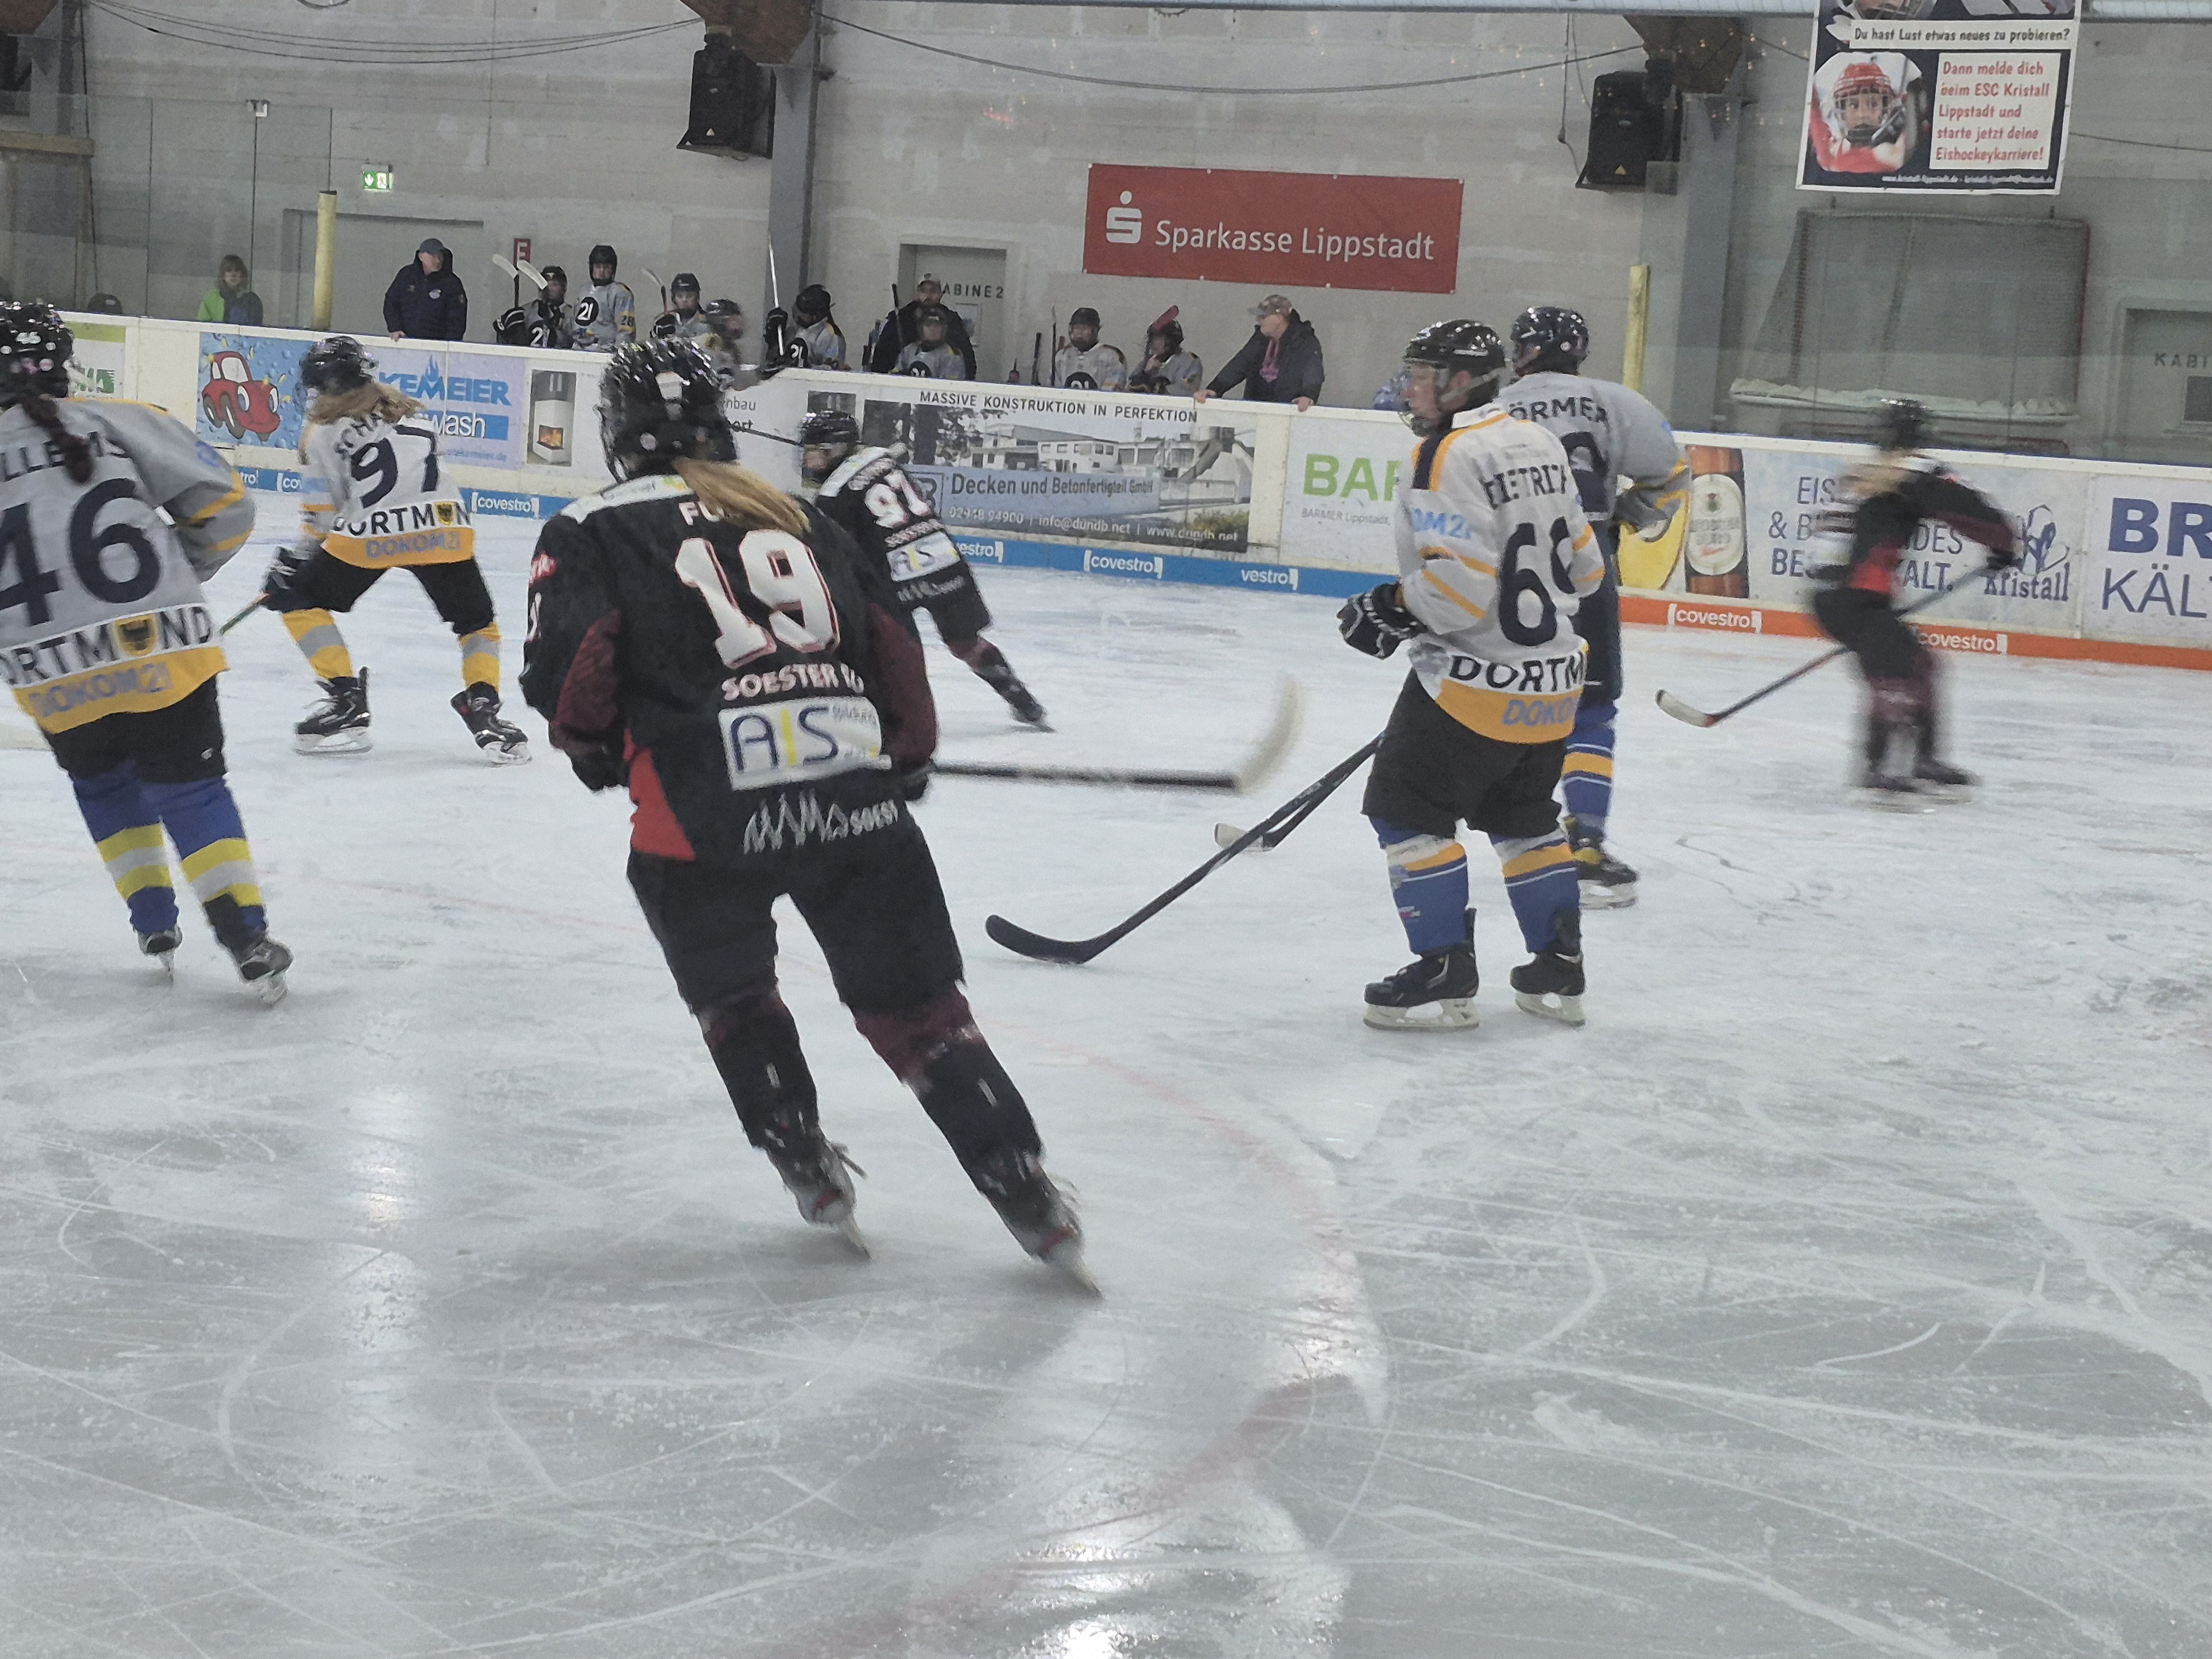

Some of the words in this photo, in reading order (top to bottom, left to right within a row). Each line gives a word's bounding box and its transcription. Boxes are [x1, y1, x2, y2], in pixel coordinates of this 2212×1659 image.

[1854, 28, 1867, 41] Du
[1872, 28, 1895, 41] hast
[1899, 29, 1922, 41] Lust
[1925, 29, 1955, 41] etwas
[1960, 30, 1990, 41] neues
[1994, 31, 2006, 41] zu
[2010, 28, 2070, 44] probieren?
[1943, 61, 1973, 75] Dann
[1977, 61, 2013, 75] melde
[2017, 61, 2043, 76] dich
[1940, 82, 1970, 97] beim
[1974, 82, 1999, 97] ESC
[2004, 82, 2049, 98] Kristall
[1938, 104, 1996, 122] Lippstadt
[1999, 105, 2022, 118] und
[1936, 127, 1972, 139] starte
[1974, 127, 2004, 143] jetzt
[2007, 127, 2039, 140] deine
[1936, 147, 2043, 164] Eishockeykarriere!
[1155, 220, 1292, 253] Sparkasse
[1301, 227, 1435, 263] Lippstadt
[723, 396, 757, 411] nbau
[920, 390, 977, 407] MASSIVE
[983, 396, 1086, 415] KONSTRUKTION
[1093, 404, 1107, 416] IN
[1114, 406, 1198, 423] PERFEKTION
[351, 424, 440, 509] 97
[951, 473, 1016, 495] Decken
[1021, 477, 1048, 494] und
[1052, 477, 1127, 497] Betonfertigteil
[1129, 479, 1154, 494] GmbH
[0, 478, 160, 627] 46
[1090, 555, 1154, 573] covestro
[674, 528, 841, 670] 19
[2101, 562, 2212, 618] KÄL
[1676, 609, 1751, 628] covestro
